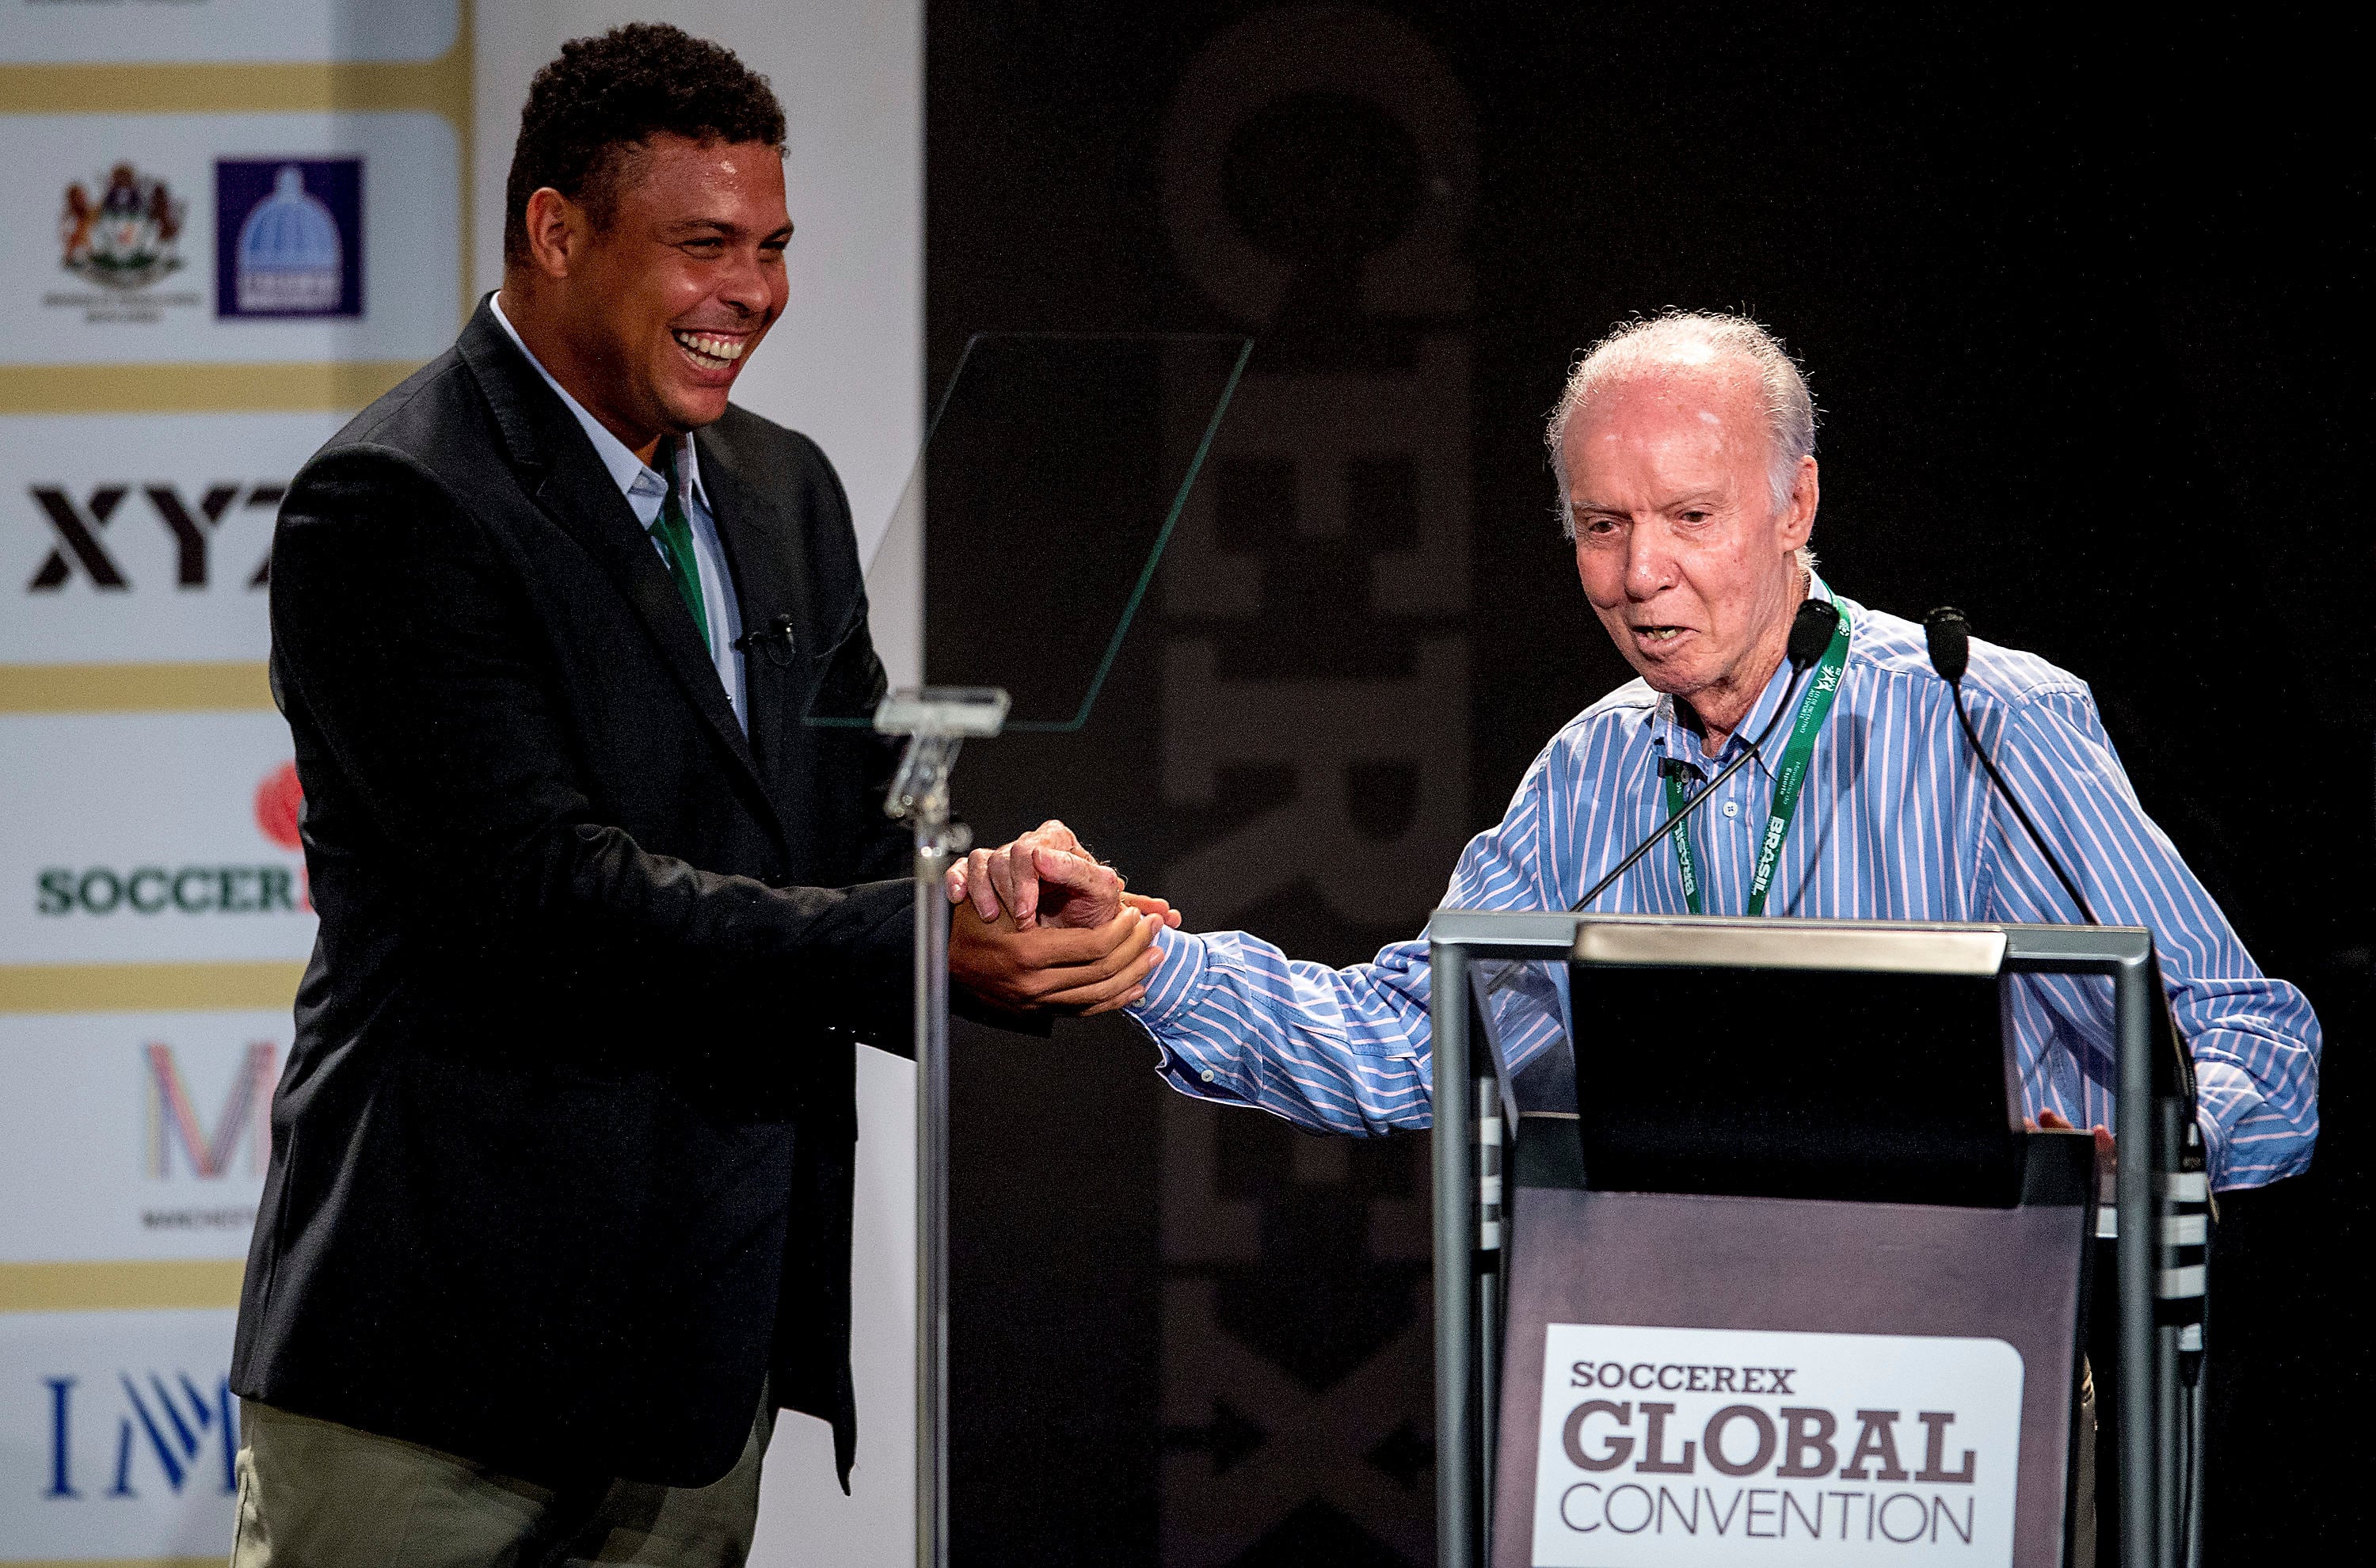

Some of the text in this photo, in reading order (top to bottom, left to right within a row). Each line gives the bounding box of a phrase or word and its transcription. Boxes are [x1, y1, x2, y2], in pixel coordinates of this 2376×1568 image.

[1673, 821, 1695, 896] BRASIL
[1751, 816, 1785, 896] BRASIL
[1569, 1361, 1796, 1395] SOCCEREX
[1562, 1398, 1977, 1484] GLOBAL
[1559, 1481, 1976, 1546] CONVENTION
